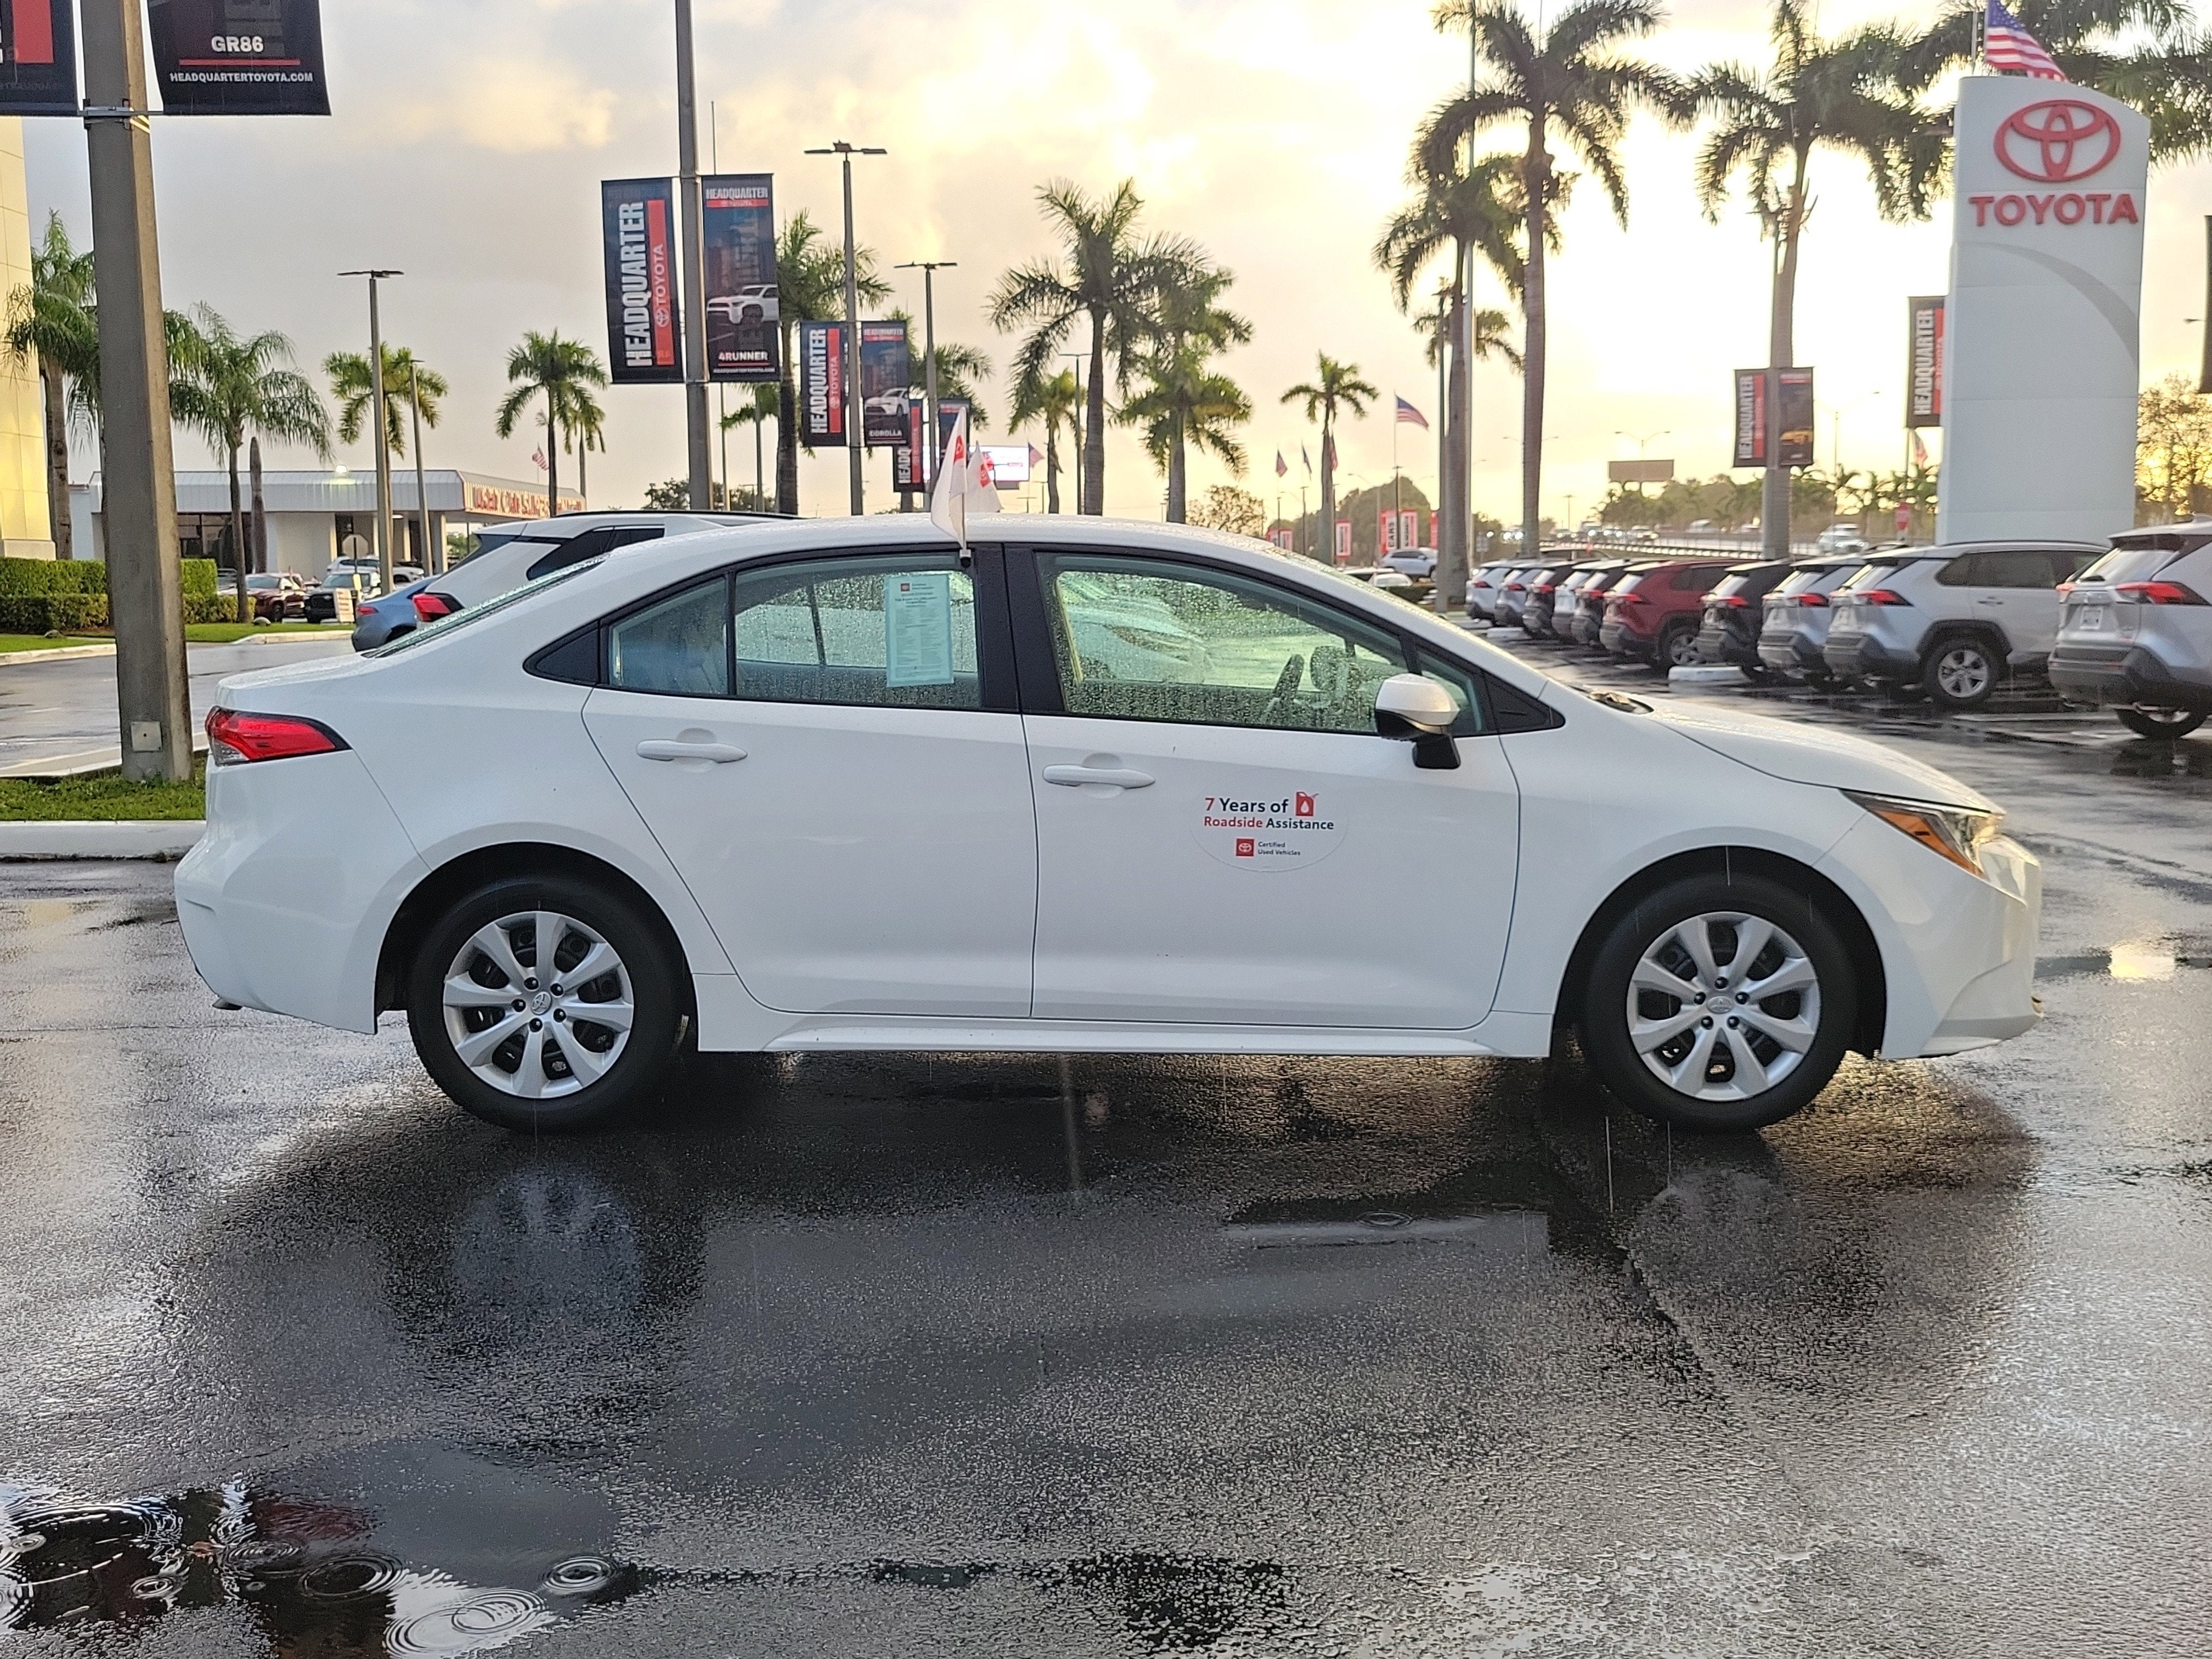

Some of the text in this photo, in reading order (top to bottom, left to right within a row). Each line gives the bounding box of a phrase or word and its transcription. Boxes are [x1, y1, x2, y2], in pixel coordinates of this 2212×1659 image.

[211, 36, 264, 52] GR86
[170, 72, 313, 83] HEADQUARTERTOYOTA.COM
[706, 187, 768, 200] HEADQUARTER
[1968, 193, 2139, 227] TOYOTA
[652, 243, 667, 306] TOYOTA
[619, 201, 652, 366] HEADQUARTER
[718, 351, 768, 361] 4RUNNER
[1914, 310, 1935, 415] HEADQUARTER
[809, 329, 829, 433] HEADQUARTER
[1205, 798, 1289, 813] 7 Years of
[1204, 816, 1334, 830] Roadside Assistance
